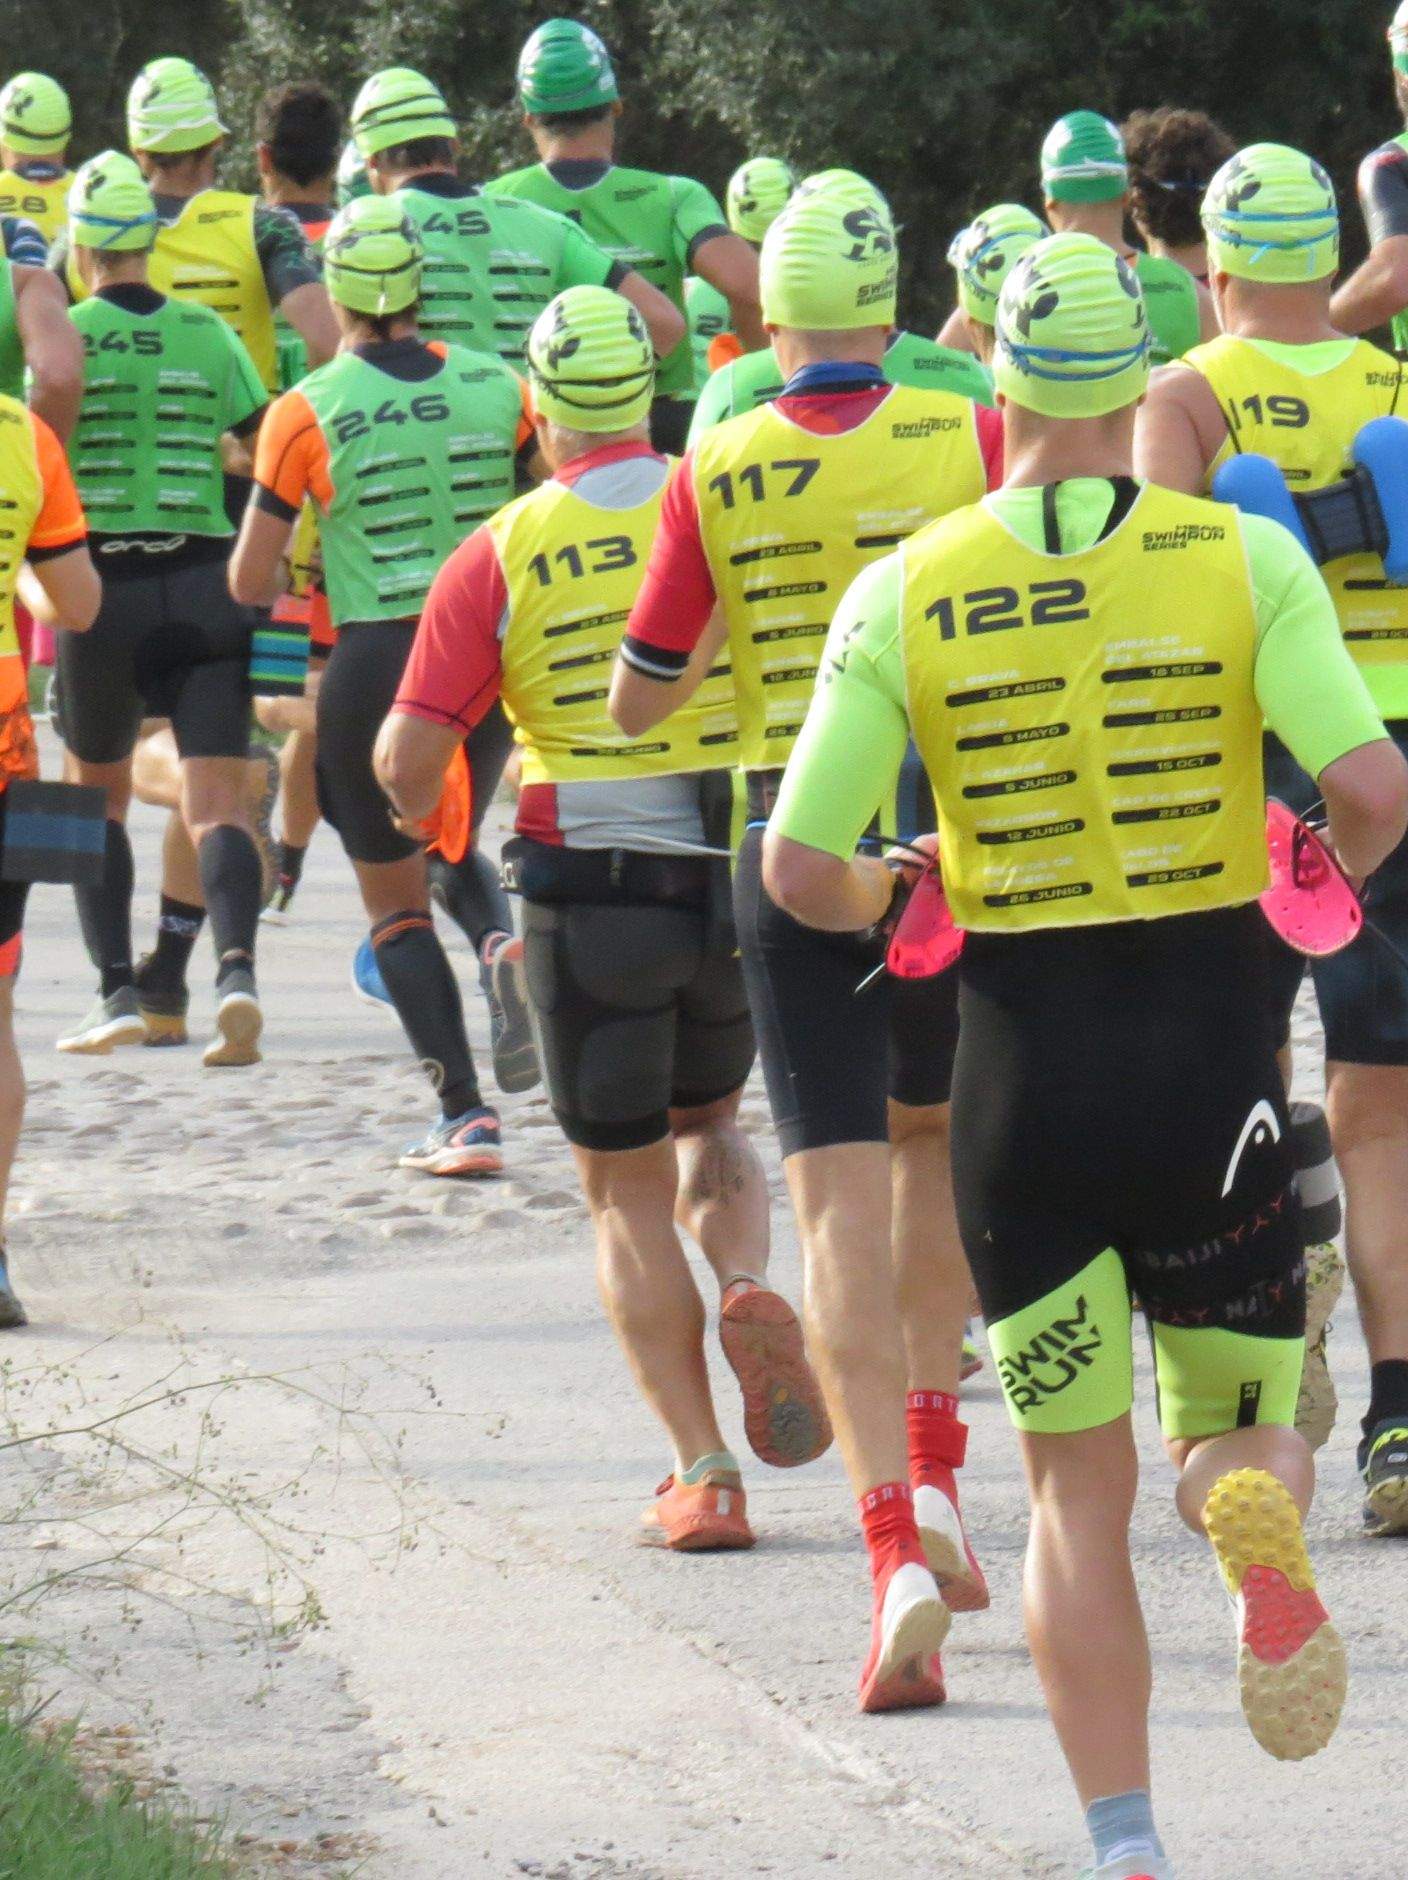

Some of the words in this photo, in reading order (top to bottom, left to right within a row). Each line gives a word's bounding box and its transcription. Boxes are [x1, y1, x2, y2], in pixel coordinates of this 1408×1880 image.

[331, 394, 450, 445] 246
[708, 458, 822, 509] 117
[1142, 529, 1226, 544] SWIMRUN
[1143, 541, 1187, 552] SERIES
[528, 535, 638, 587] 113
[924, 578, 1091, 641] 122
[1171, 664, 1205, 676] SEP
[988, 688, 1010, 699] 23
[1013, 681, 1062, 695] ABRIL
[1180, 708, 1212, 720] SEP
[1016, 726, 1060, 741] MAYO
[1176, 757, 1206, 768] OCT
[1018, 774, 1068, 790] JUNIO
[1183, 804, 1211, 816] OCT
[1026, 822, 1075, 839] JUNIO
[1171, 867, 1202, 880] OCT
[1032, 885, 1083, 901] JUNIO
[999, 1294, 1088, 1389] SWIM
[1009, 1322, 1102, 1416] RUN
